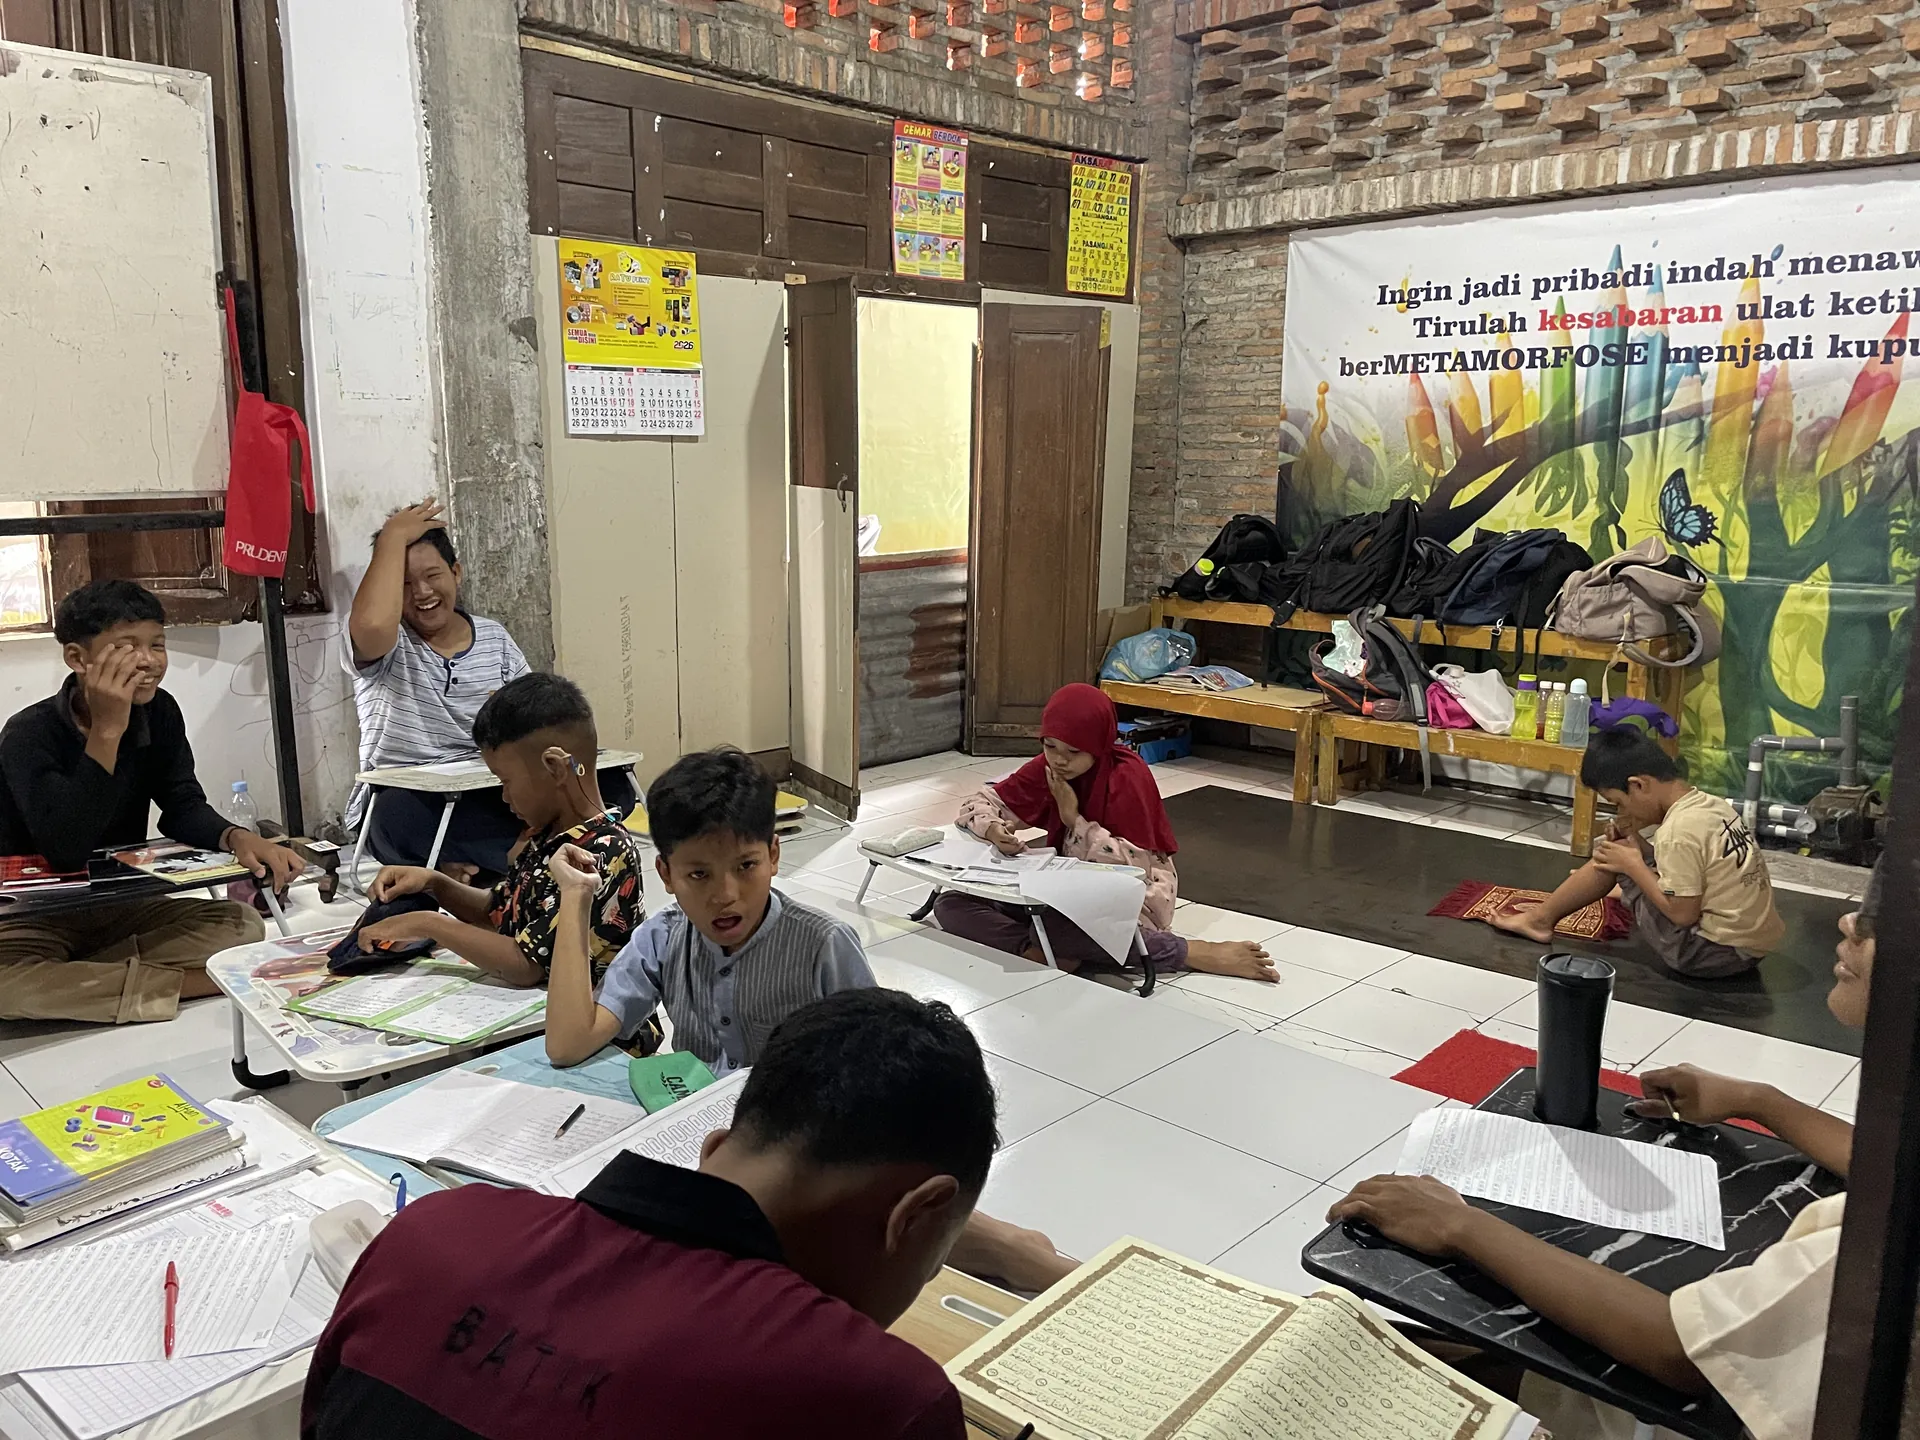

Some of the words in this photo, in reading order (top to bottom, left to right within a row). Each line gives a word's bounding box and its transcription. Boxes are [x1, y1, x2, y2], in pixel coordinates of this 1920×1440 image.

[903, 124, 932, 138] GEMAR
[1376, 280, 1453, 309] Ingin
[1458, 273, 1522, 306] jadi
[1530, 262, 1655, 301] pribadi
[1666, 254, 1775, 285] indah
[1412, 311, 1528, 338] Tirulah
[1537, 303, 1724, 332] kesabaran
[1736, 293, 1815, 321] ulat
[567, 328, 588, 337] SEMUA
[578, 337, 597, 345] DISINI
[1339, 341, 1650, 377] berMETAMORFOSE
[1661, 334, 1814, 370] menjadi
[618, 388, 625, 396] 10
[627, 388, 633, 396] 11
[571, 397, 578, 405] 12
[581, 397, 588, 405] 13
[591, 398, 598, 406] 14
[601, 398, 607, 406] 15
[610, 398, 617, 406] 16
[619, 398, 625, 406] 17
[649, 400, 656, 408] 10
[658, 400, 664, 408] 11
[667, 400, 673, 408] 12
[676, 400, 682, 408] 13
[685, 400, 691, 408] 14
[694, 401, 700, 409] 15
[572, 408, 579, 416] 19
[582, 408, 589, 416] 20
[591, 408, 598, 416] 21
[601, 409, 608, 417] 22
[610, 409, 617, 417] 23
[619, 409, 626, 417] 24
[628, 409, 635, 417] 25
[641, 410, 647, 418] 16
[650, 410, 656, 418] 17
[659, 410, 665, 418] 18
[668, 410, 674, 418] 19
[676, 410, 683, 418] 20
[685, 410, 691, 418] 21
[694, 411, 701, 419] 22
[572, 419, 580, 427] 26
[582, 419, 589, 427] 27
[592, 419, 599, 427] 28
[601, 419, 608, 427] 29
[611, 419, 618, 427] 30
[620, 419, 626, 427] 31
[641, 420, 648, 428] 23
[650, 420, 656, 428] 24
[659, 420, 666, 428] 25
[668, 420, 675, 428] 26
[677, 420, 683, 428] 27
[686, 420, 692, 428] 28
